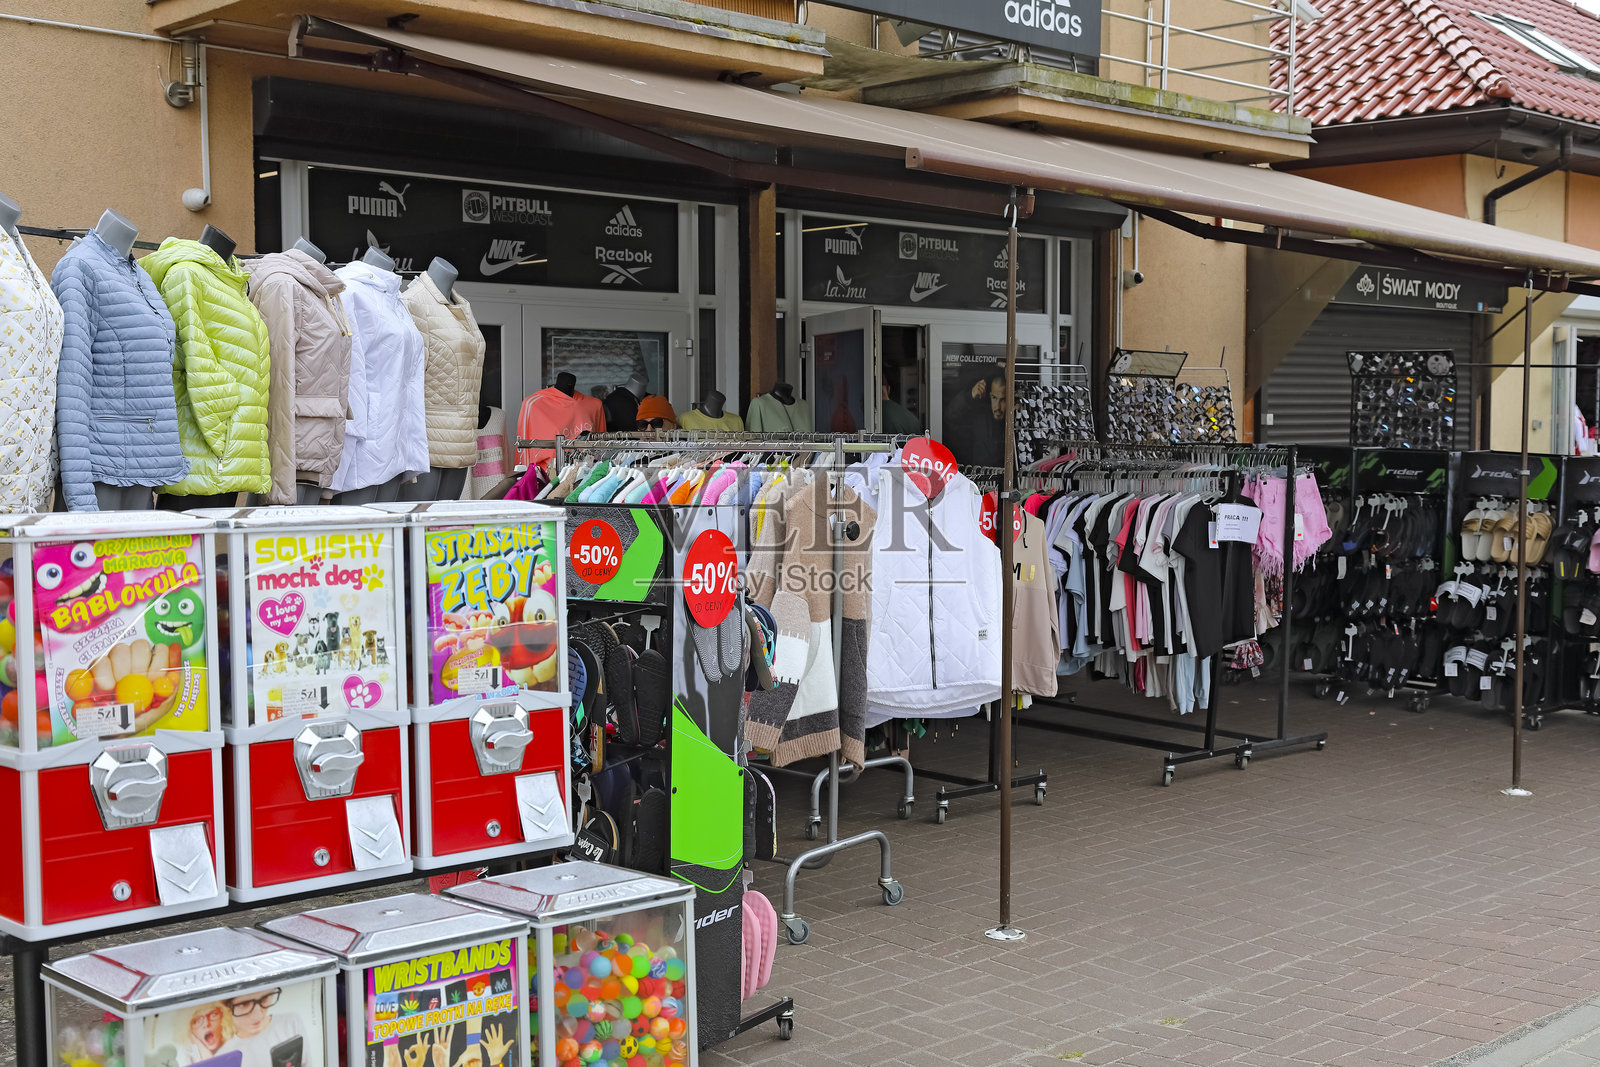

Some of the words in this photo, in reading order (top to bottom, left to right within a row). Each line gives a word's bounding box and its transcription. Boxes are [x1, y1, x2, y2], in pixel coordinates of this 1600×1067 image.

[1004, 0, 1082, 37] adidas
[348, 195, 398, 217] PUMA
[492, 196, 553, 215] PITBULL
[605, 223, 643, 238] adidas
[487, 239, 526, 260] NIKE
[595, 246, 653, 264] Reebok
[824, 238, 858, 256] PUMA
[918, 236, 959, 252] PITBULL
[915, 271, 941, 289] NIKE
[1382, 273, 1422, 297] ŚWIAT
[1425, 281, 1461, 300] MODY
[960, 355, 998, 363] COLLECTION
[1385, 468, 1423, 477] rider
[92, 533, 193, 558] ORYGINALNA
[254, 532, 385, 566] SQUISHY
[429, 521, 545, 567] STRASZNE
[573, 544, 618, 566] -50%
[102, 548, 187, 574] MARKOWA
[594, 567, 613, 577] CENY
[256, 560, 321, 591] mochi
[324, 564, 363, 591] dog
[440, 551, 538, 616] ZĘBY
[683, 561, 739, 596] -50%
[50, 562, 200, 631] BĄBLOKULA
[269, 619, 282, 628] my
[283, 614, 298, 625] dog
[275, 604, 298, 616] love
[373, 938, 512, 994] WRISTBANDS
[373, 1017, 424, 1039] TOPOWE
[425, 1004, 466, 1027] FROTKI
[466, 1000, 482, 1017] NA
[485, 993, 512, 1016] RĘKĘ
[374, 1001, 397, 1015] LOVE
